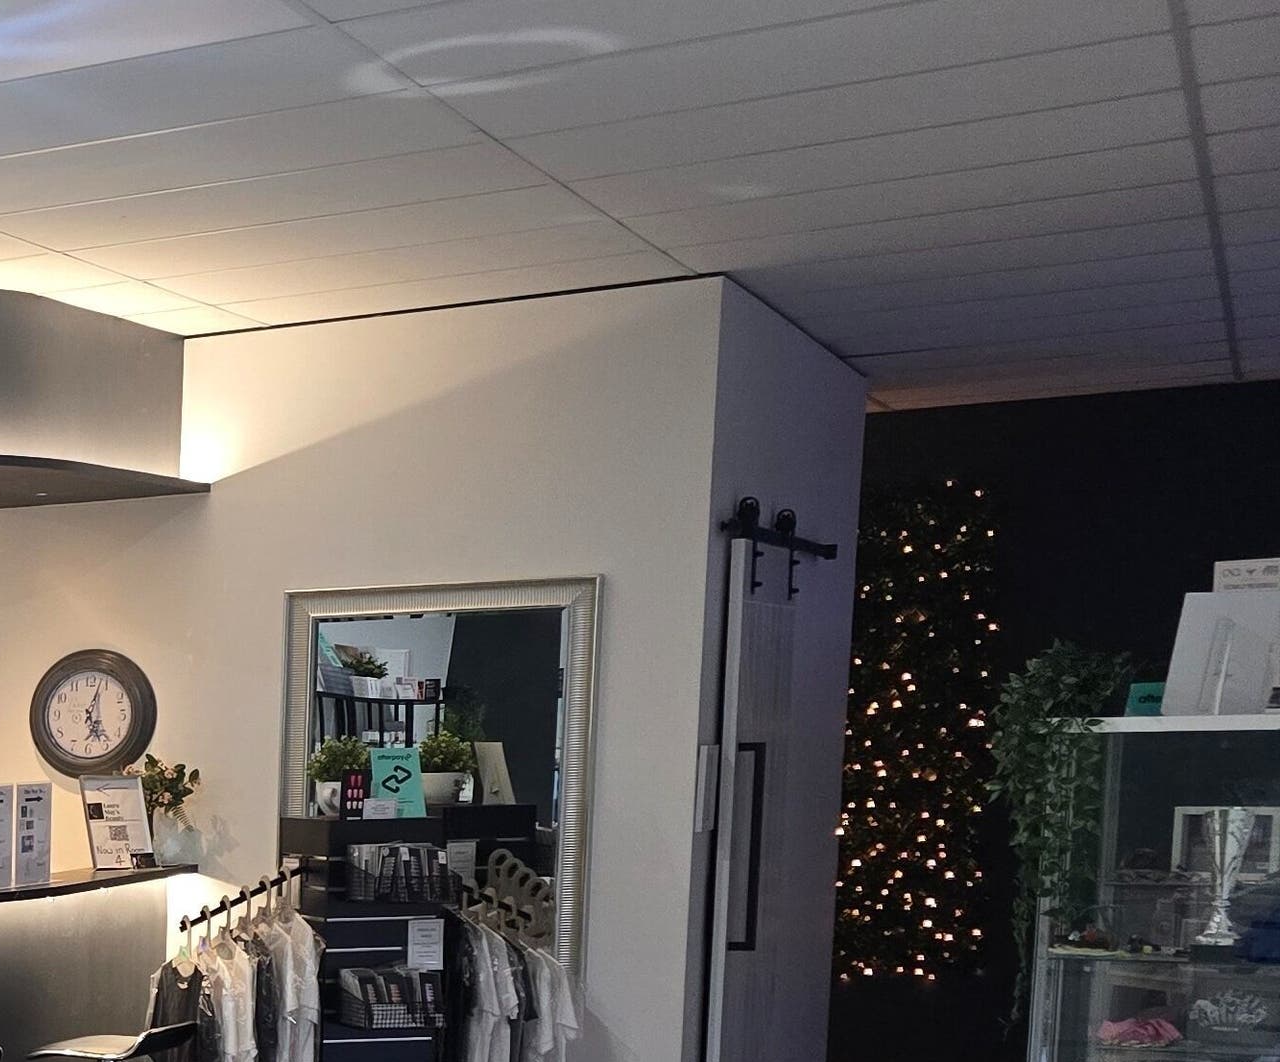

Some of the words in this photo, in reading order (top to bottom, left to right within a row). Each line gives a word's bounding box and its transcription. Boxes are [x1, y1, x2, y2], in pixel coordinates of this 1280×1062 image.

[85, 675, 97, 688] 12
[57, 692, 67, 704] 10
[53, 709, 61, 721] 9
[56, 727, 64, 739] 8
[96, 845, 113, 855] Now
[115, 854, 125, 866] 4
